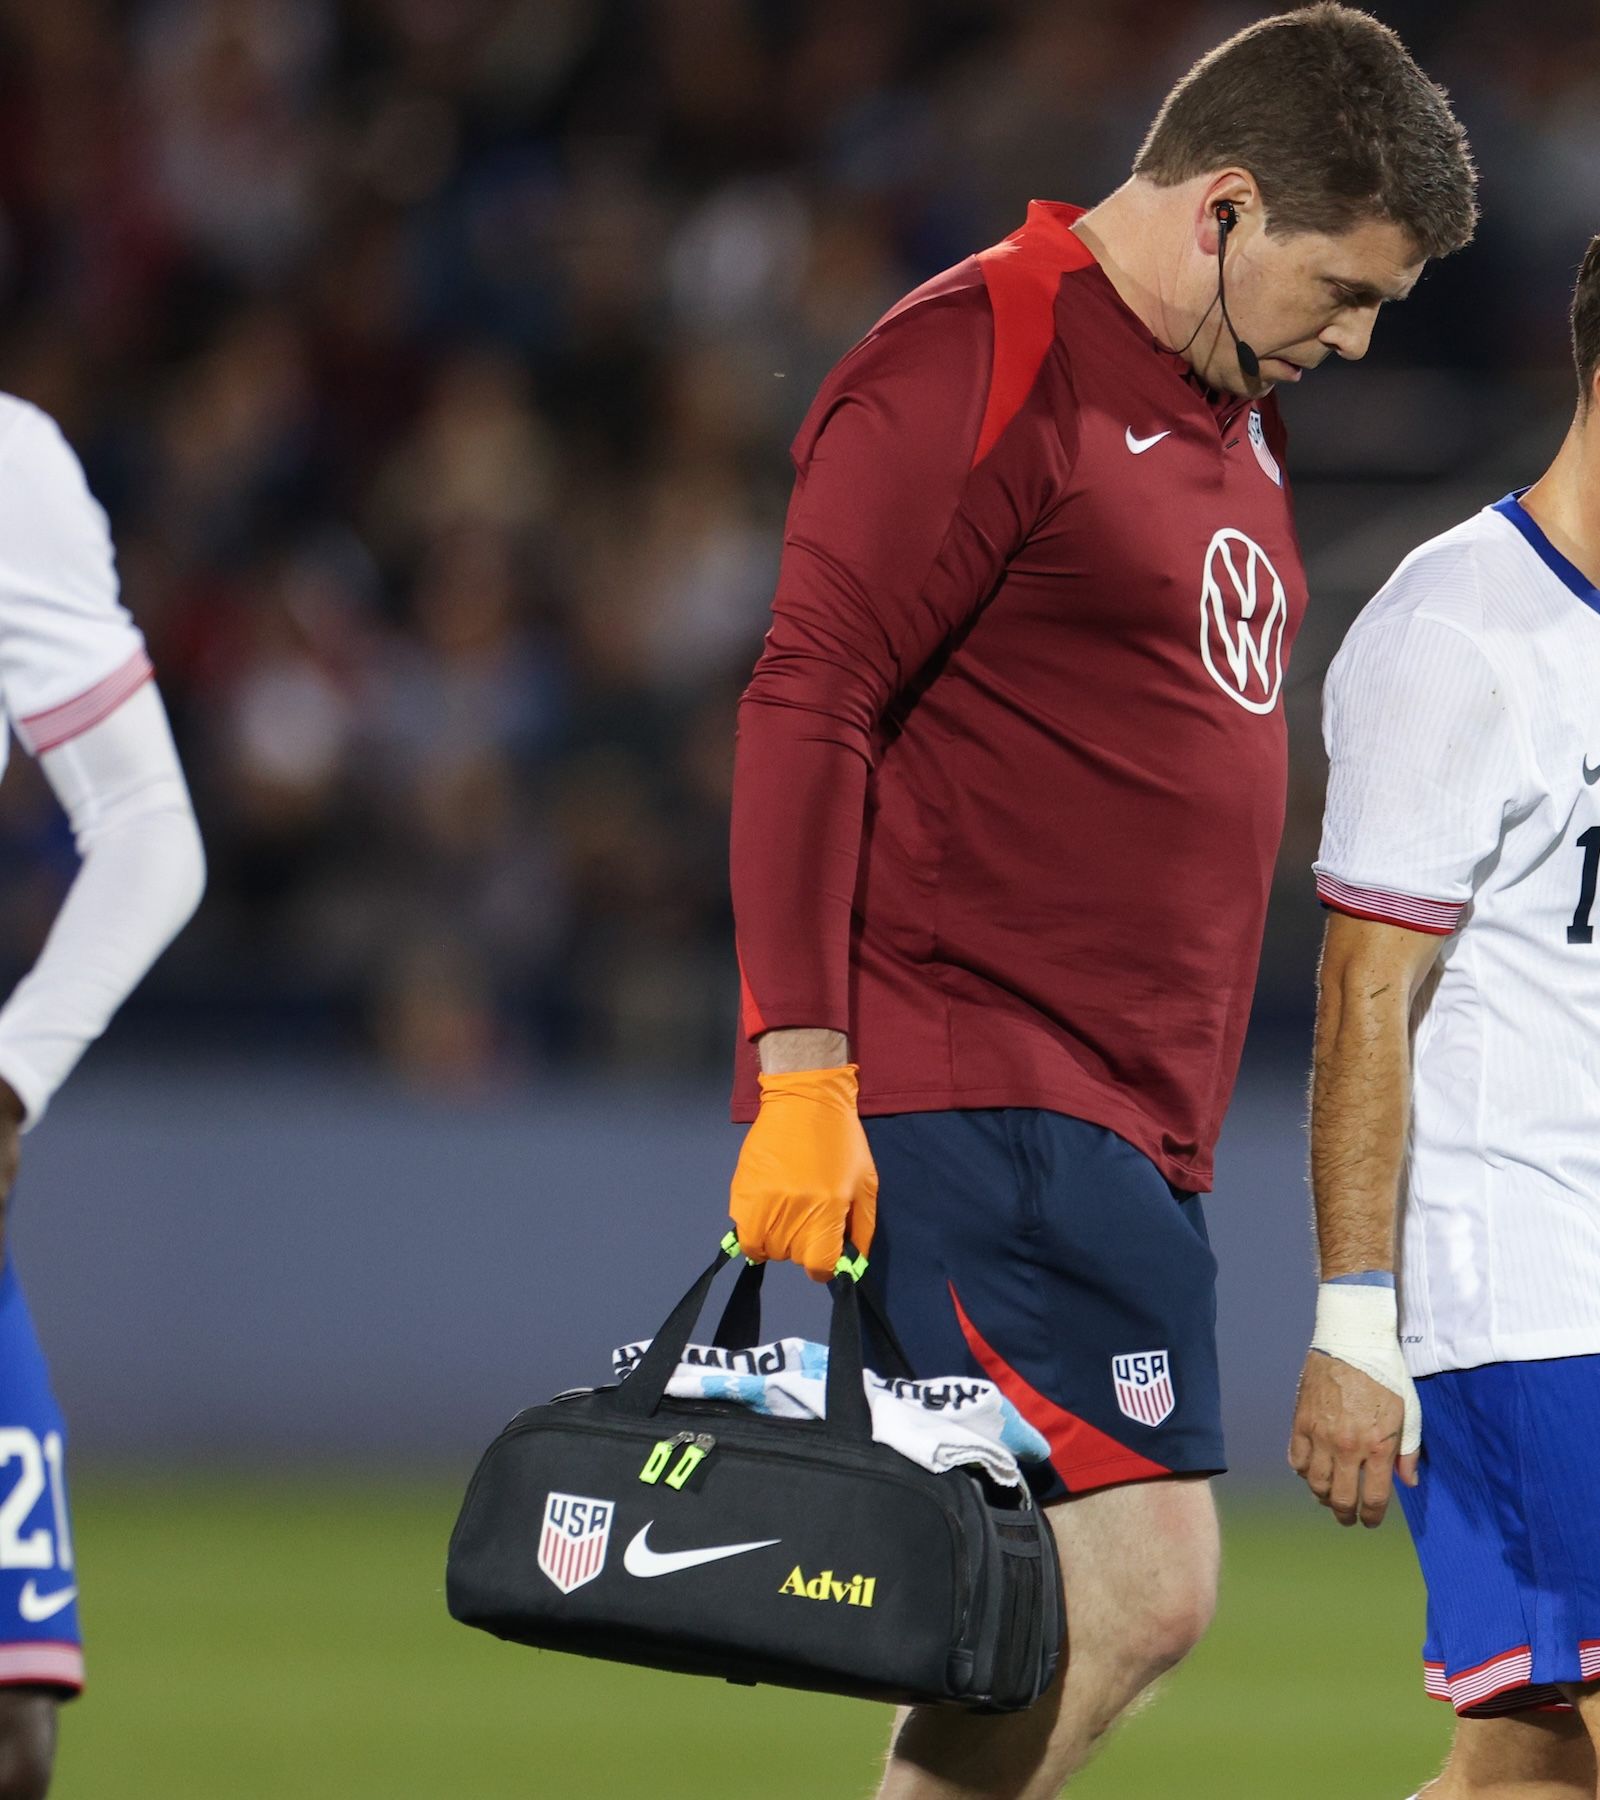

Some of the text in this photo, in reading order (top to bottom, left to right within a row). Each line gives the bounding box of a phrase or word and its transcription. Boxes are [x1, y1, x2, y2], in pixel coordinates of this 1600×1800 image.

[1115, 1354, 1165, 1386] USA
[0, 1426, 74, 1571] 21
[549, 1499, 608, 1538] USA
[777, 1564, 876, 1608] Advil
